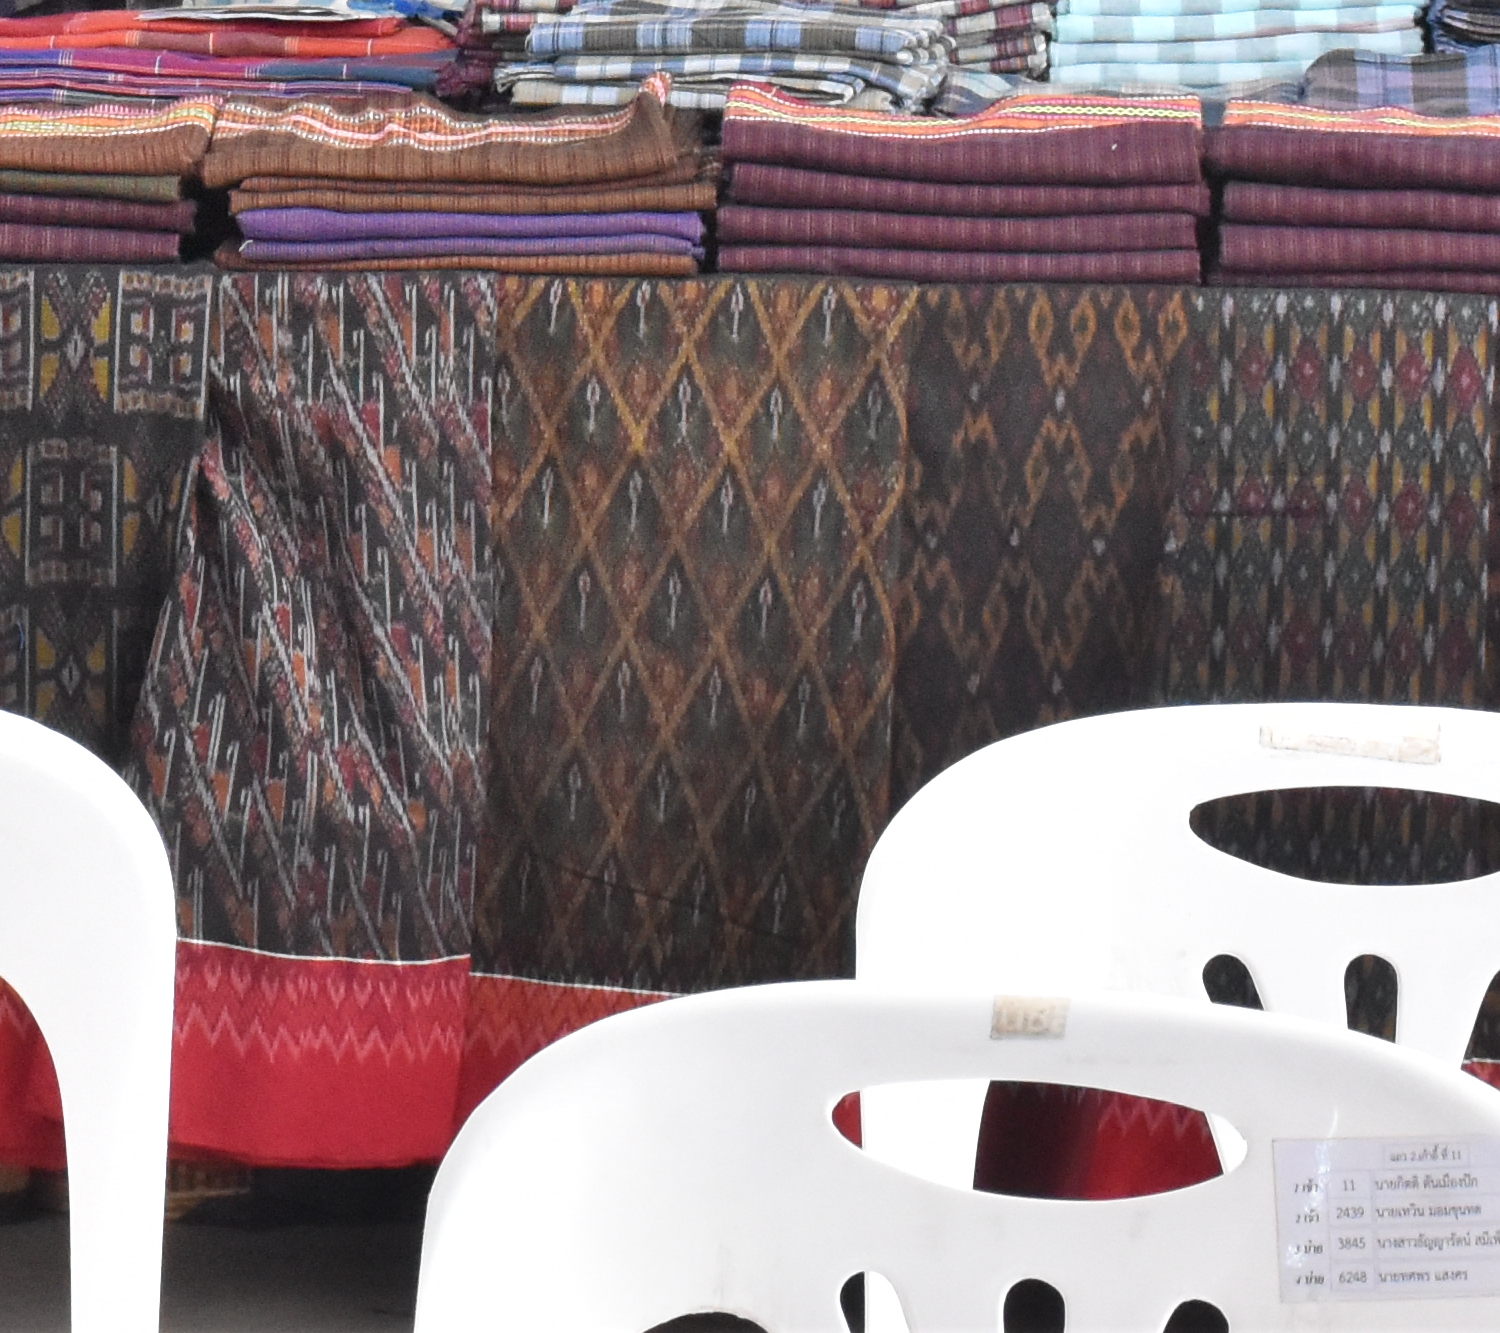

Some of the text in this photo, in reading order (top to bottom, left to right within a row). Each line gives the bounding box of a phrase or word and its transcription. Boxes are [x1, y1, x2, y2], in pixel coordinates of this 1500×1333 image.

[1342, 1179, 1355, 1192] 11
[1336, 1206, 1365, 1220] 2439
[1337, 1236, 1366, 1250] 3845
[1338, 1270, 1368, 1284] 6248
